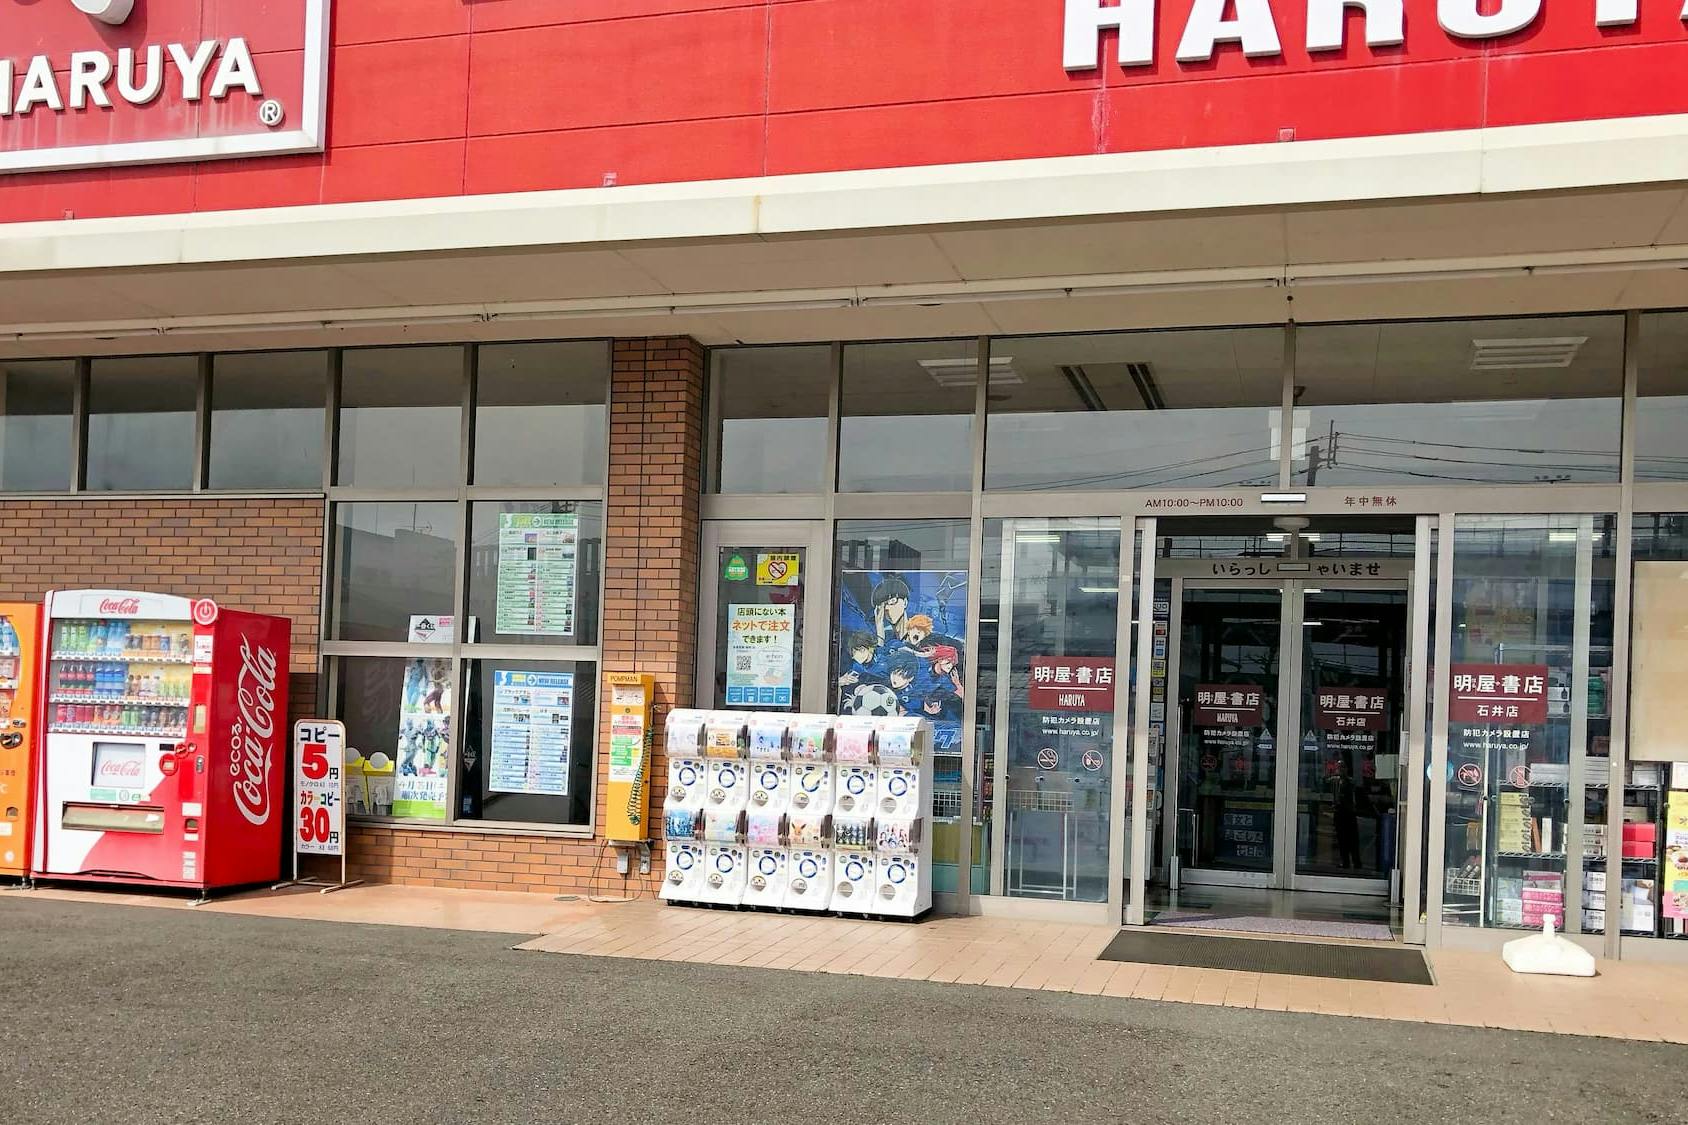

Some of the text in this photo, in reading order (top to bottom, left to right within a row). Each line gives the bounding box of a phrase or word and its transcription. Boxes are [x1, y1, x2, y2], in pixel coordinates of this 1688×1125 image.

[1344, 496, 1397, 507] 年中無休
[737, 607, 786, 616] 店頭にない本
[732, 620, 790, 632] ネットで注文
[1058, 693, 1086, 707] HARUYA
[1477, 705, 1519, 717] 石井店
[1336, 717, 1366, 727] 石井店
[300, 726, 340, 743] コピー
[1463, 728, 1530, 739] 防犯カメラ設置店
